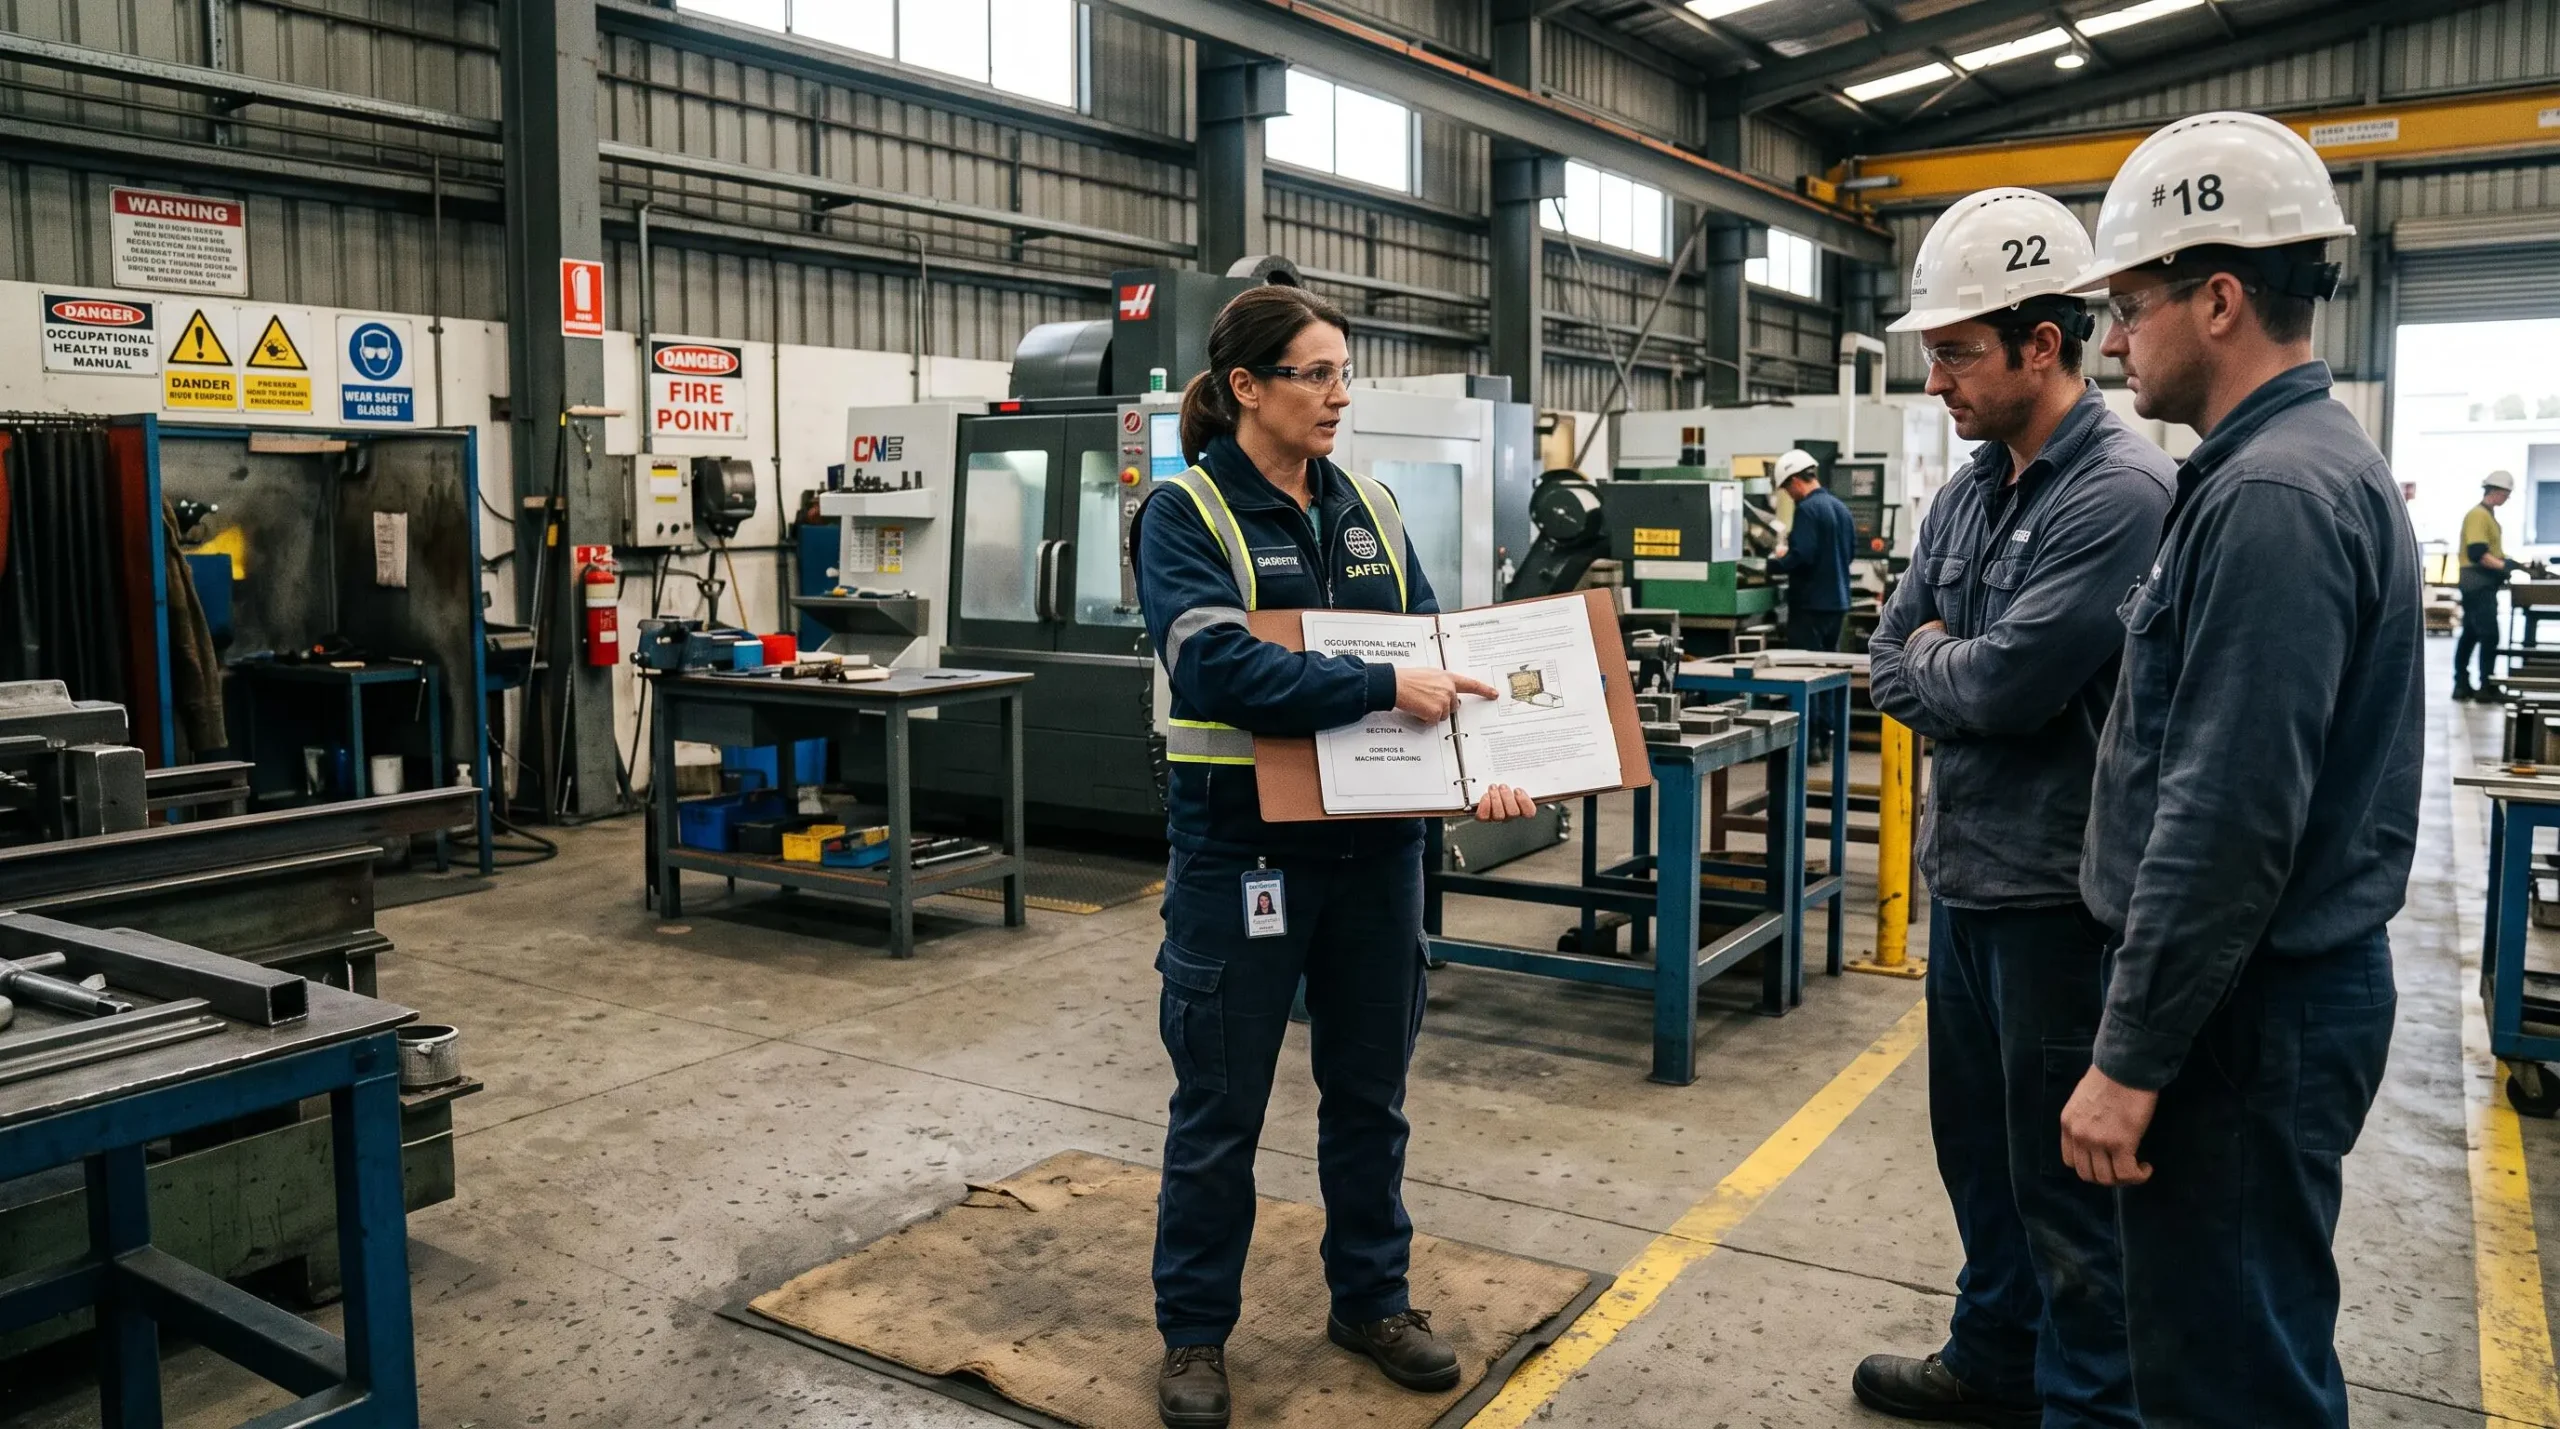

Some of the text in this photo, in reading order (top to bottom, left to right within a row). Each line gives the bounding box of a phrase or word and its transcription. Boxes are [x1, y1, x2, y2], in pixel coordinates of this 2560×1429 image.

[2152, 173, 2225, 216] #18
[127, 196, 228, 222] WARNING
[2002, 234, 2051, 272] 22
[64, 304, 134, 321] DANGER
[46, 329, 154, 345] OCCUPATIONAL
[53, 343, 108, 355] HEALTH
[73, 357, 132, 370] MANUAL
[663, 351, 730, 370] DANGER
[171, 377, 230, 390] DANDER
[344, 390, 410, 404] WEAR SAFETY
[669, 381, 724, 404] FIRE
[356, 404, 398, 417] GLASSES
[657, 408, 734, 432] POINT
[1345, 563, 1391, 578] SAFETY
[1386, 640, 1417, 649] HEALTH
